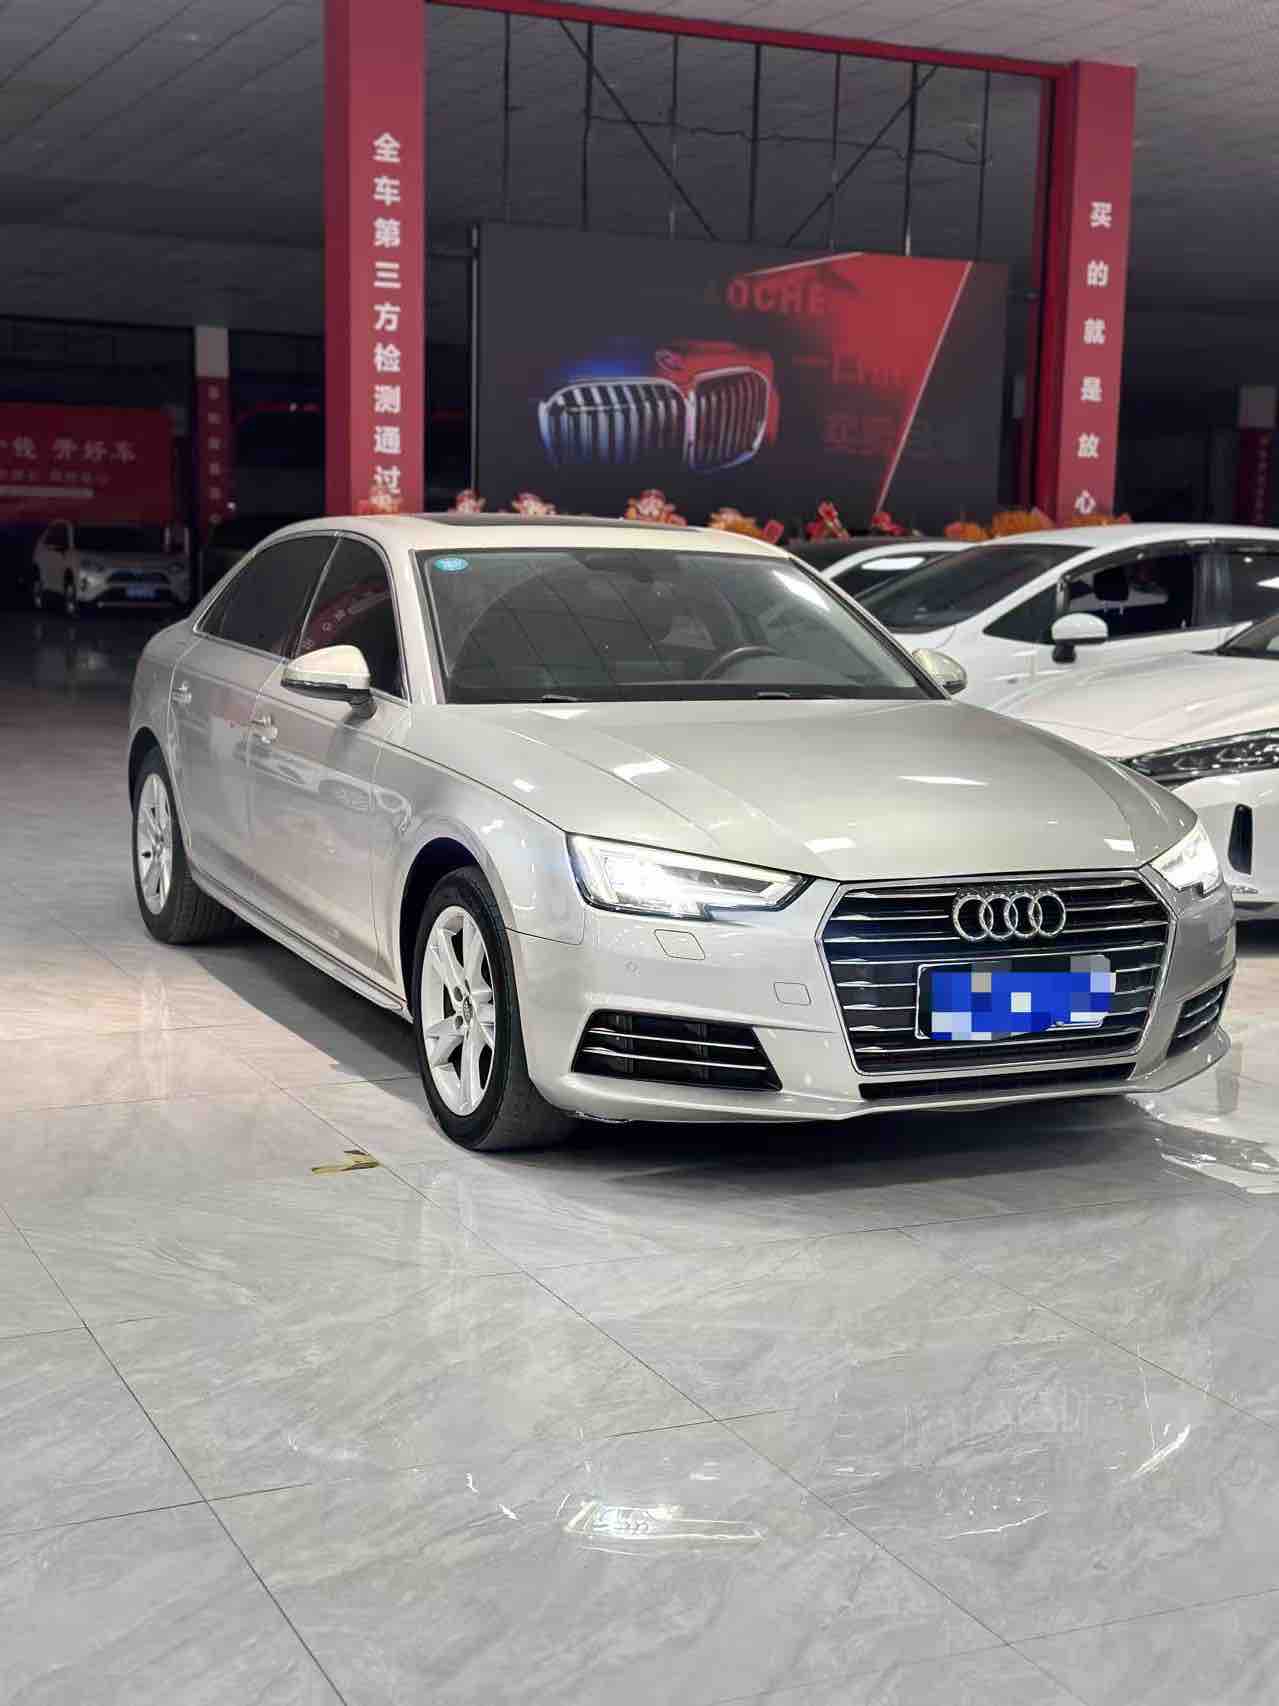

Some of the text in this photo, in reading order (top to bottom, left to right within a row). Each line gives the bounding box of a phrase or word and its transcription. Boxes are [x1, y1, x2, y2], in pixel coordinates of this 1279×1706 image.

[373, 132, 402, 494] 全车第三方检测通过
[1075, 201, 1113, 515] 买的就是放心
